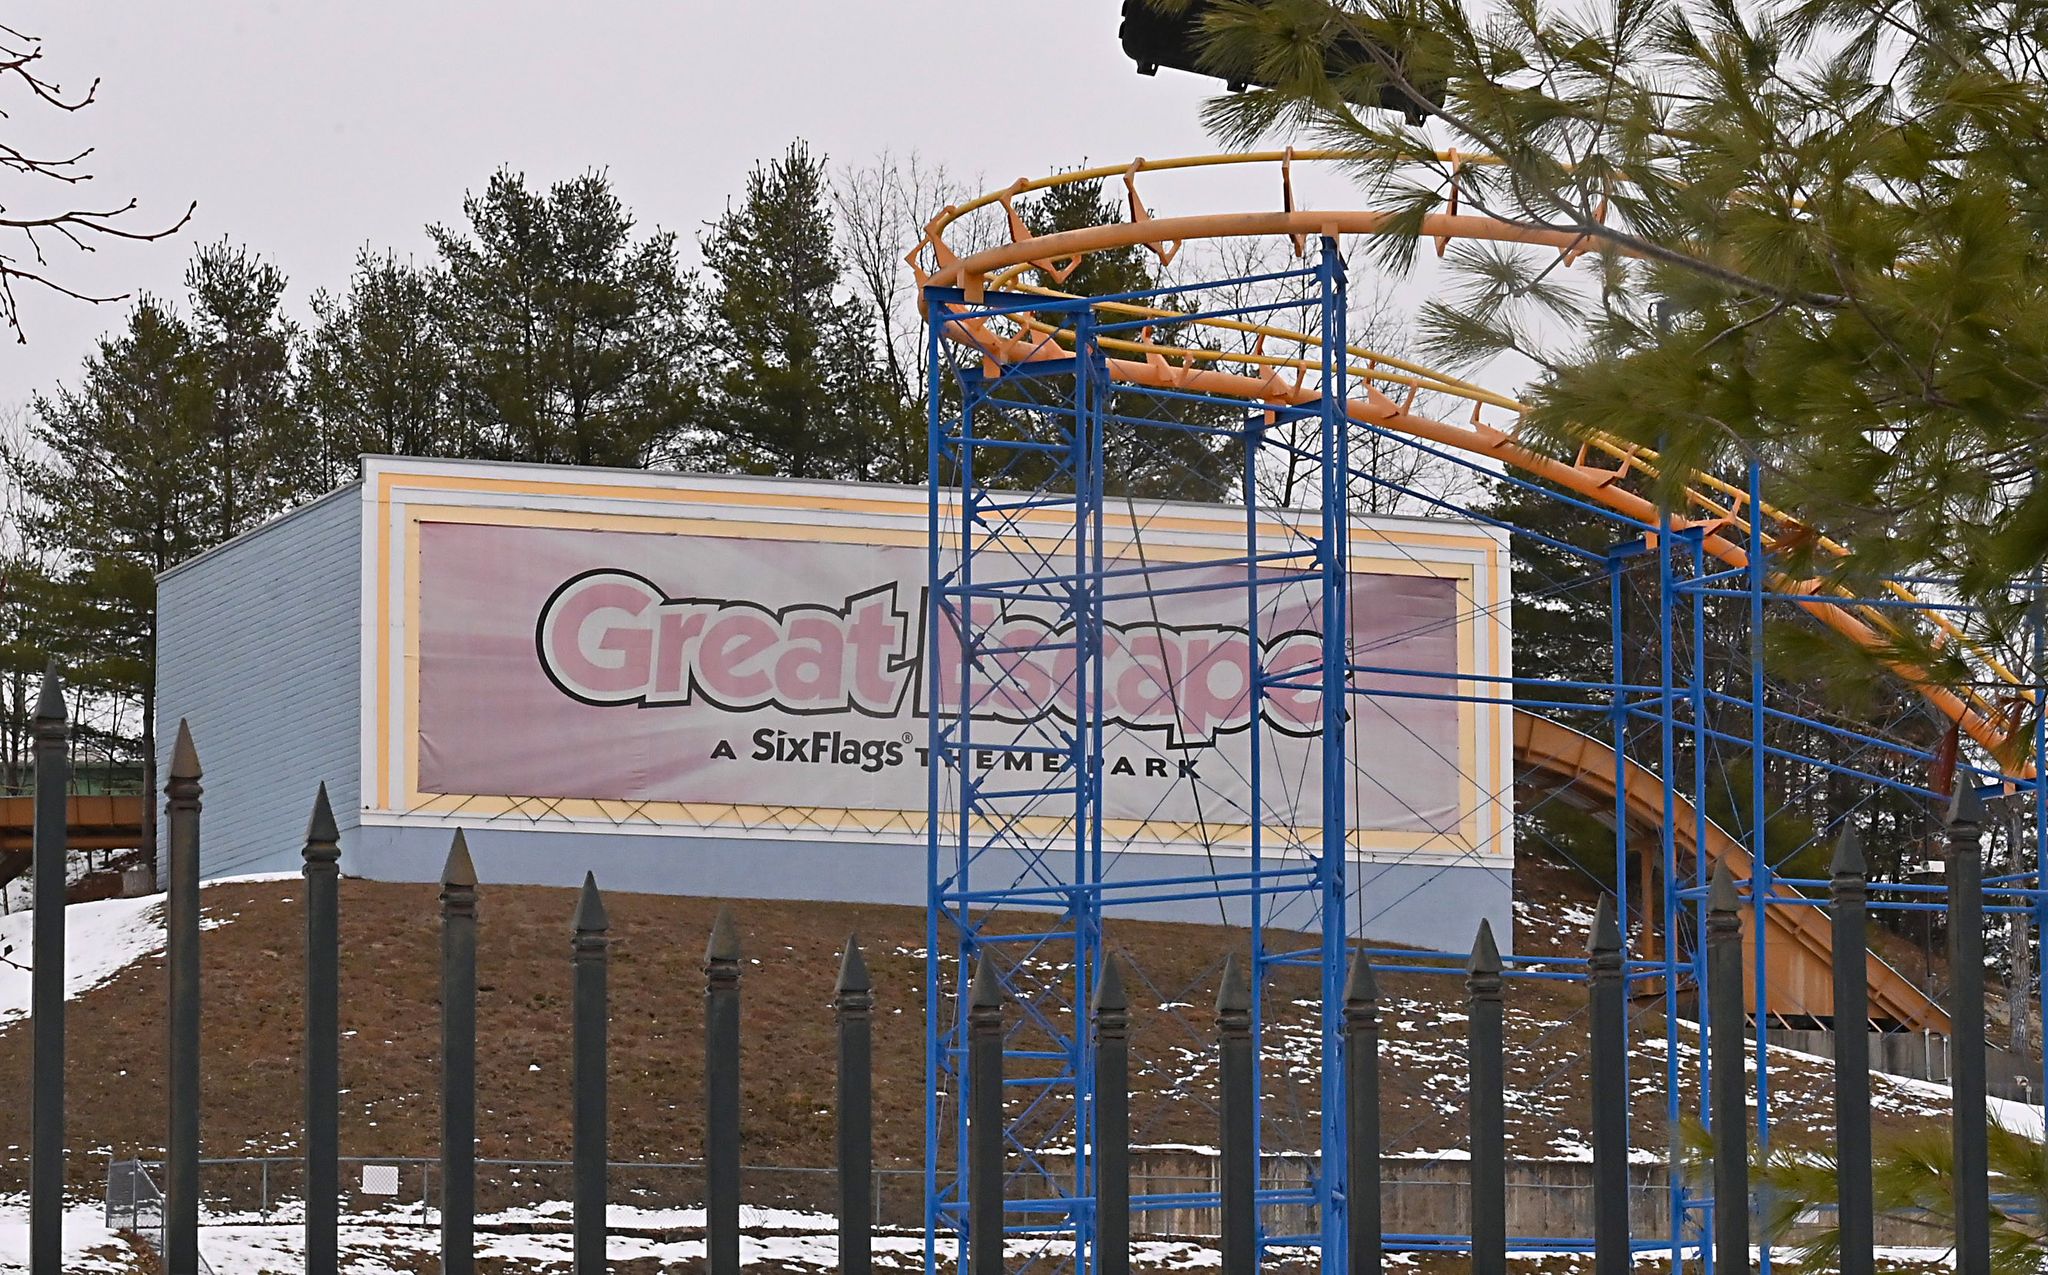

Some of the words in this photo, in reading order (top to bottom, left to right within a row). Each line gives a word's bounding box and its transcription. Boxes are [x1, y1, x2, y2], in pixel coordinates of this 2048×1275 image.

[539, 571, 905, 713] Great
[920, 590, 1344, 745] Escape
[710, 740, 737, 760] A
